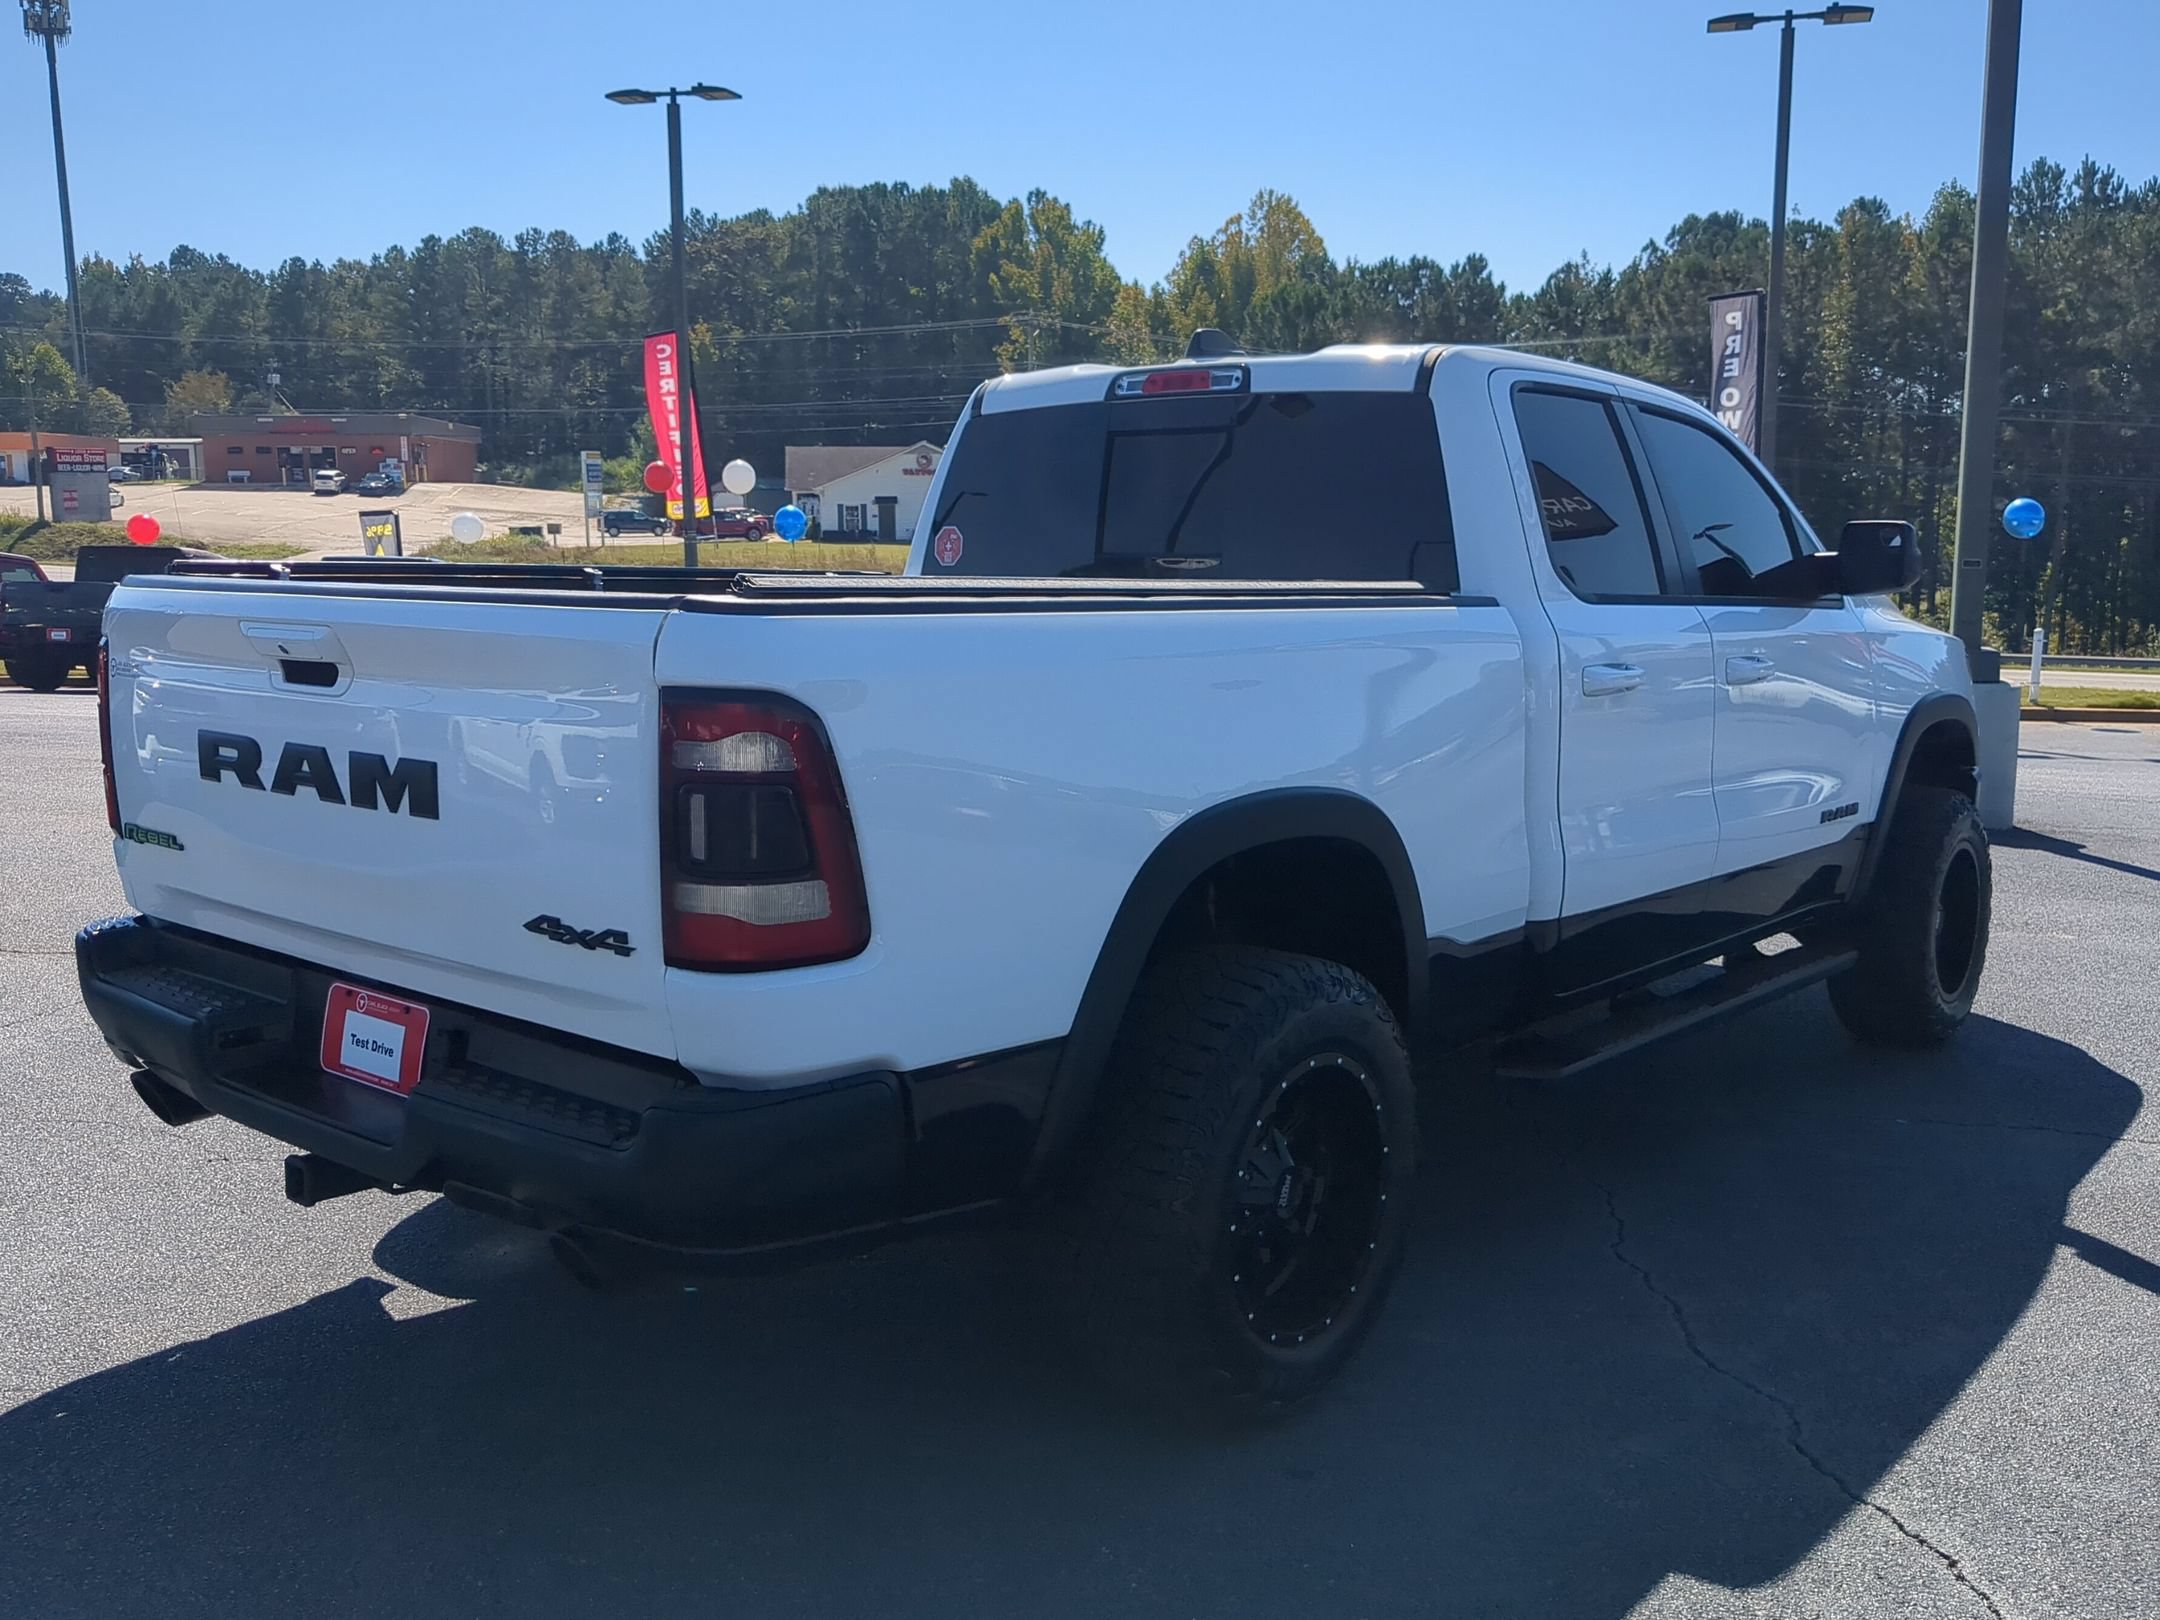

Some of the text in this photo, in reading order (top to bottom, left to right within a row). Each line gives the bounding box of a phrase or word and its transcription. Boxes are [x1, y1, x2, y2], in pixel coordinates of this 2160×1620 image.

[56, 453, 82, 462] LIQUOR
[83, 453, 105, 463] STORE
[198, 729, 440, 821] RAM
[124, 822, 185, 851] REBEL
[350, 1033, 394, 1058] Test Drive
